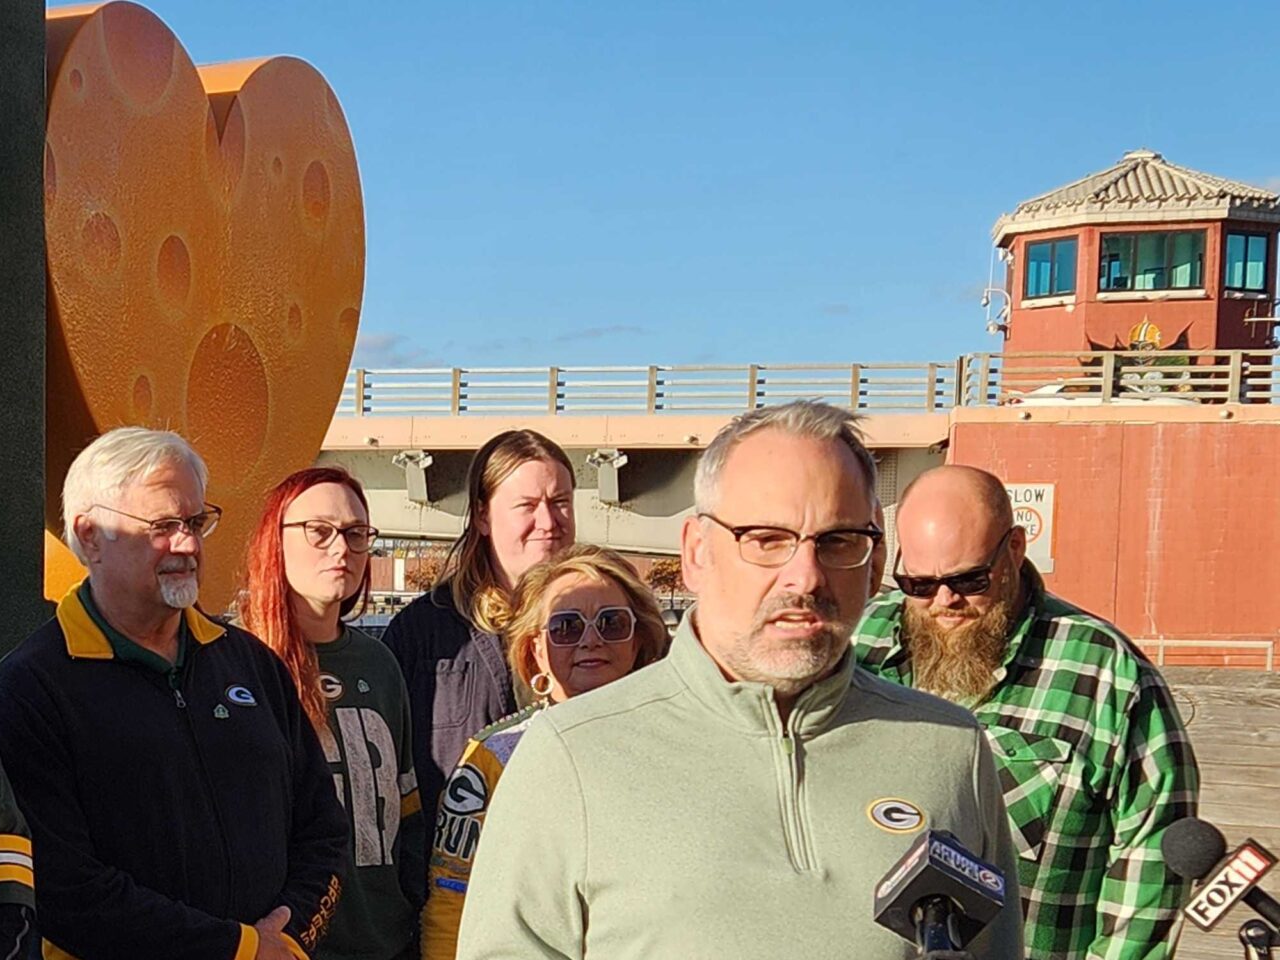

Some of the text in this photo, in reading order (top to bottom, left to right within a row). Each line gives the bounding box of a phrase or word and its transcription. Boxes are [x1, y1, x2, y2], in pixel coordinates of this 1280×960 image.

[1006, 488, 1045, 503] SLOW
[1016, 510, 1032, 522] NO
[227, 685, 257, 704] G
[319, 674, 343, 699] G
[444, 765, 487, 814] G
[872, 800, 922, 830] G
[1192, 871, 1244, 922] FOX
